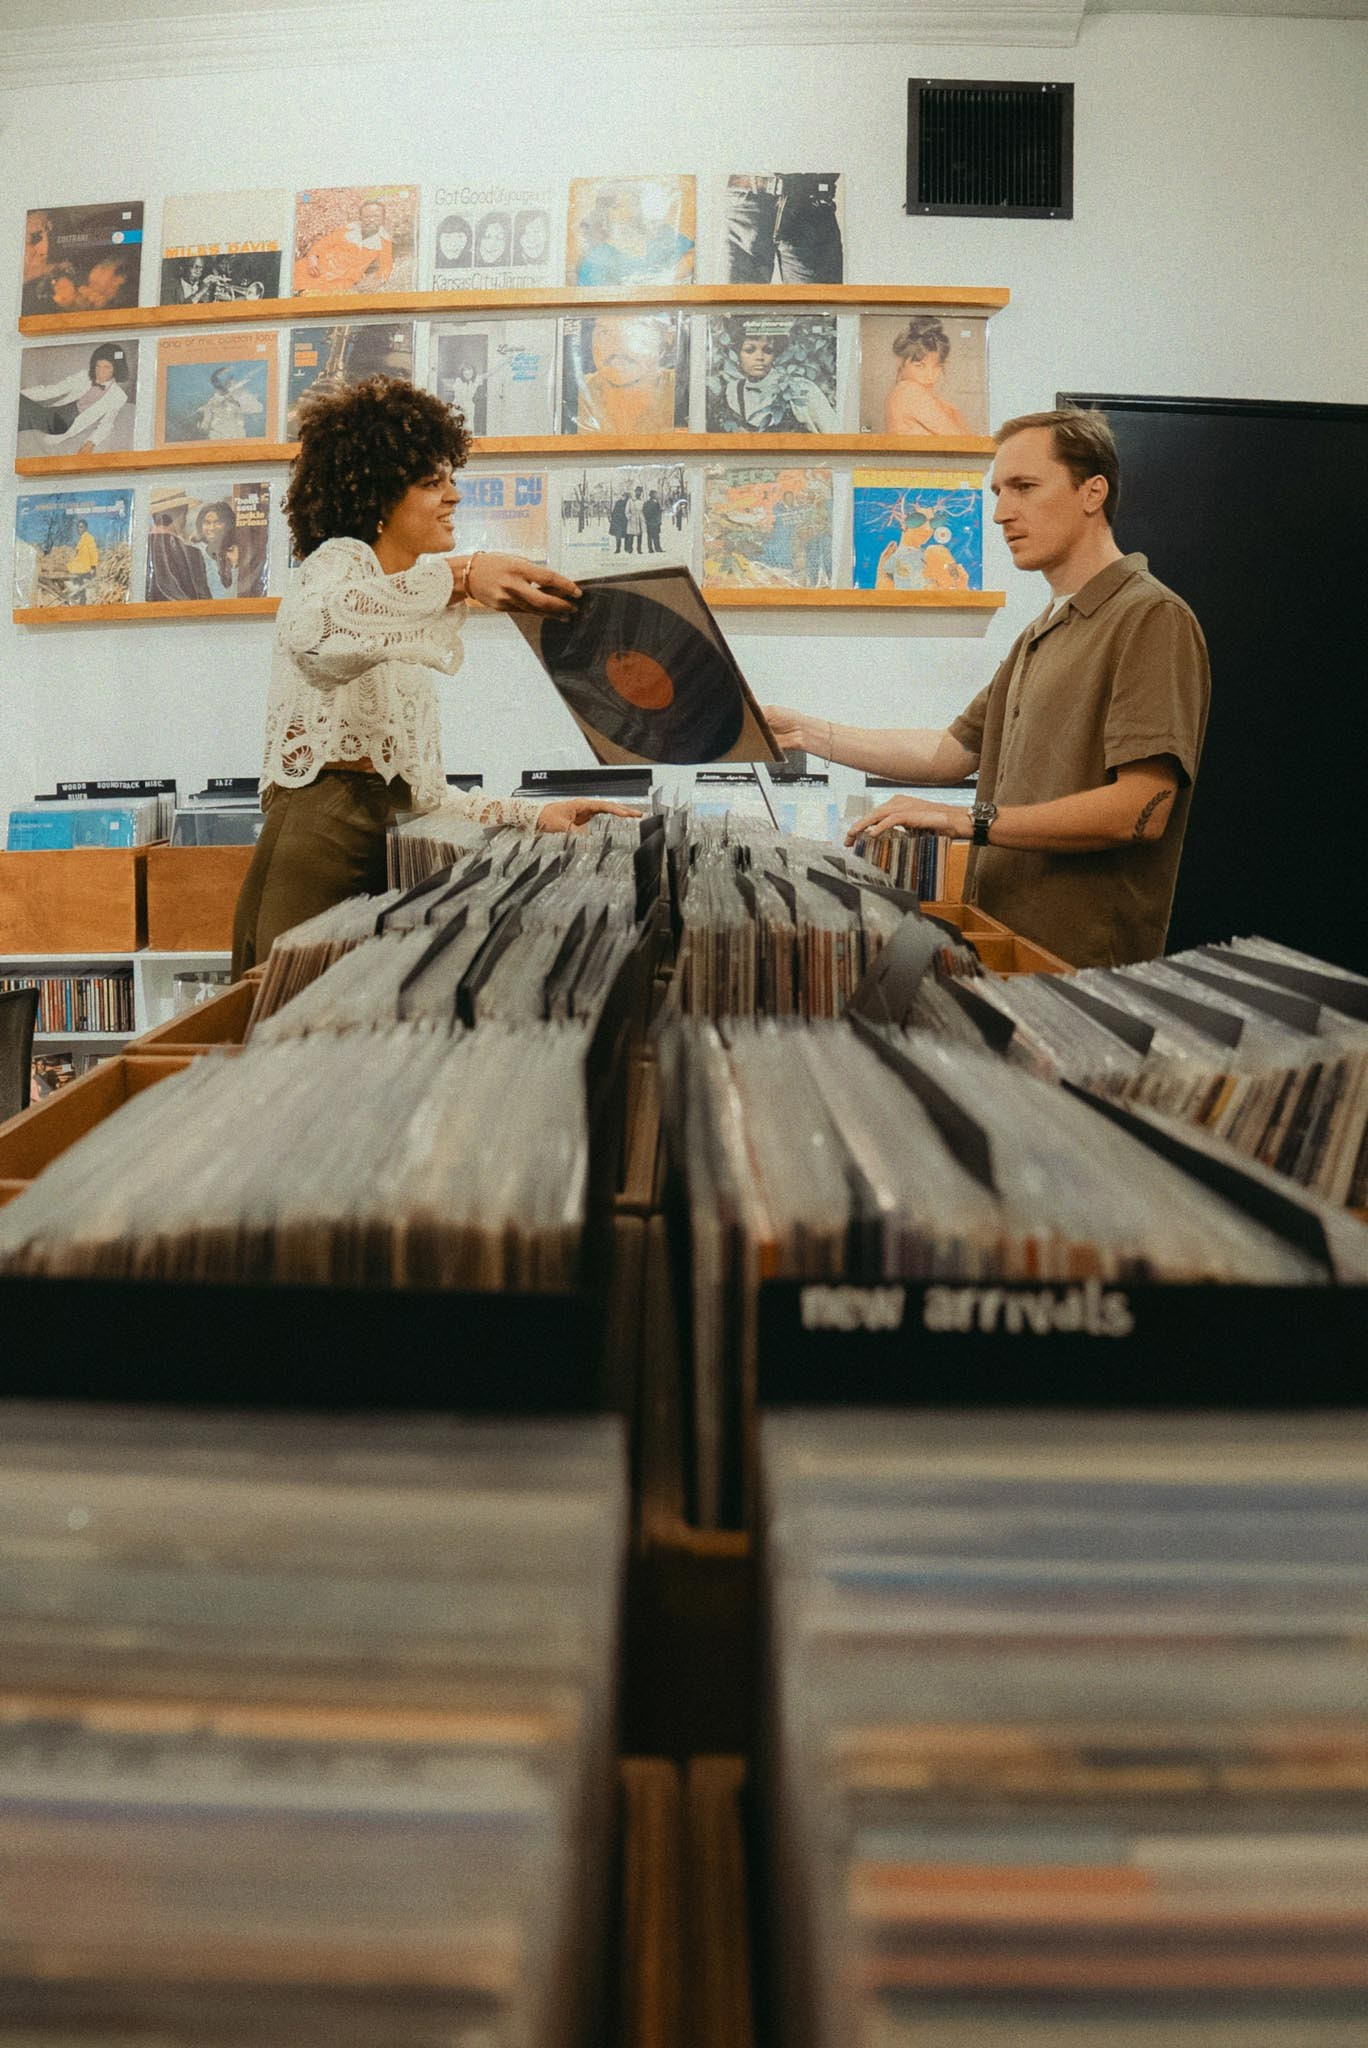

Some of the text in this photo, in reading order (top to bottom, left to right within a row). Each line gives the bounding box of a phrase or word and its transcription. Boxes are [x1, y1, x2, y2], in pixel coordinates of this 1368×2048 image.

[165, 240, 279, 257] MILES DAVIS
[531, 771, 549, 780] JAZZ
[62, 782, 87, 791] WORDS
[97, 780, 140, 789] SOUNDTRACK
[215, 778, 233, 787] JAZZ
[801, 1276, 1134, 1338] new arrivals
